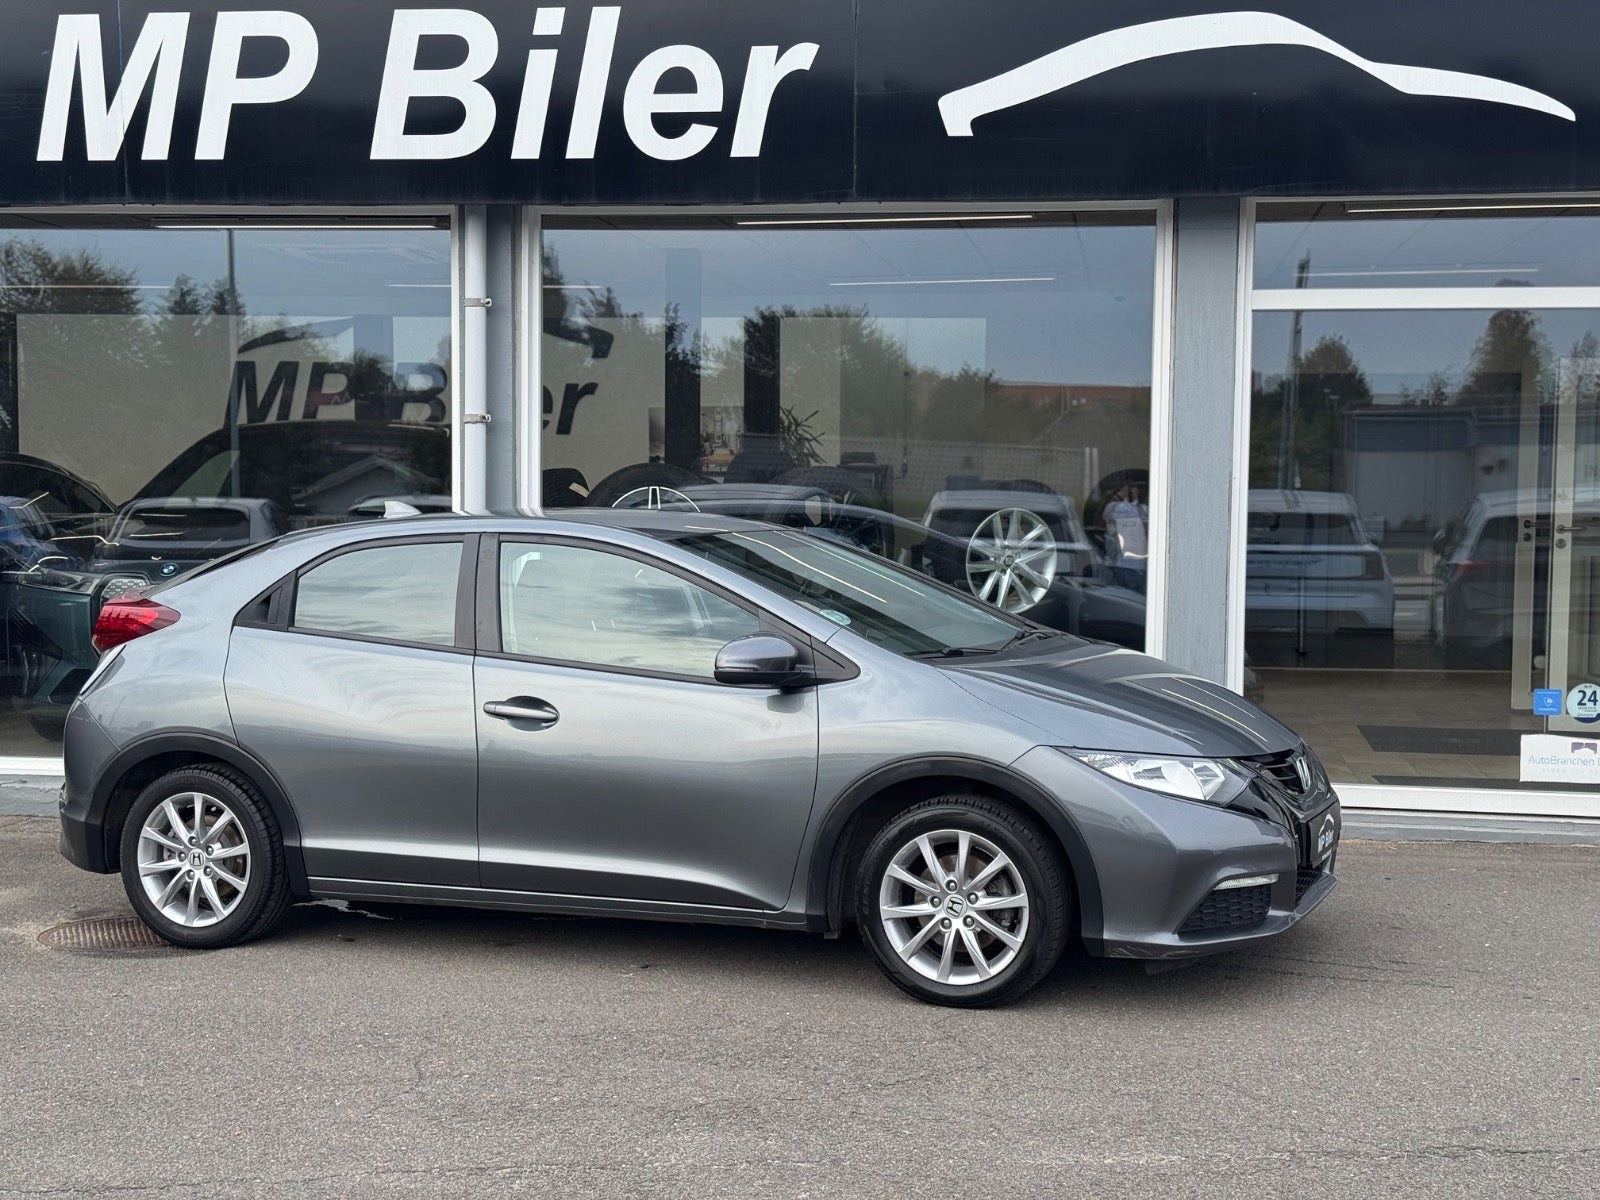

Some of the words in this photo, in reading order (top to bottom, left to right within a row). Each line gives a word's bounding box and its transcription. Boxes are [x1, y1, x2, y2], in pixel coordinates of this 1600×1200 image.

[37, 10, 319, 162] MP
[369, 5, 820, 161] Biler
[224, 361, 355, 429] MP
[1577, 690, 1599, 706] 24
[1528, 755, 1595, 767] AutoBranchen
